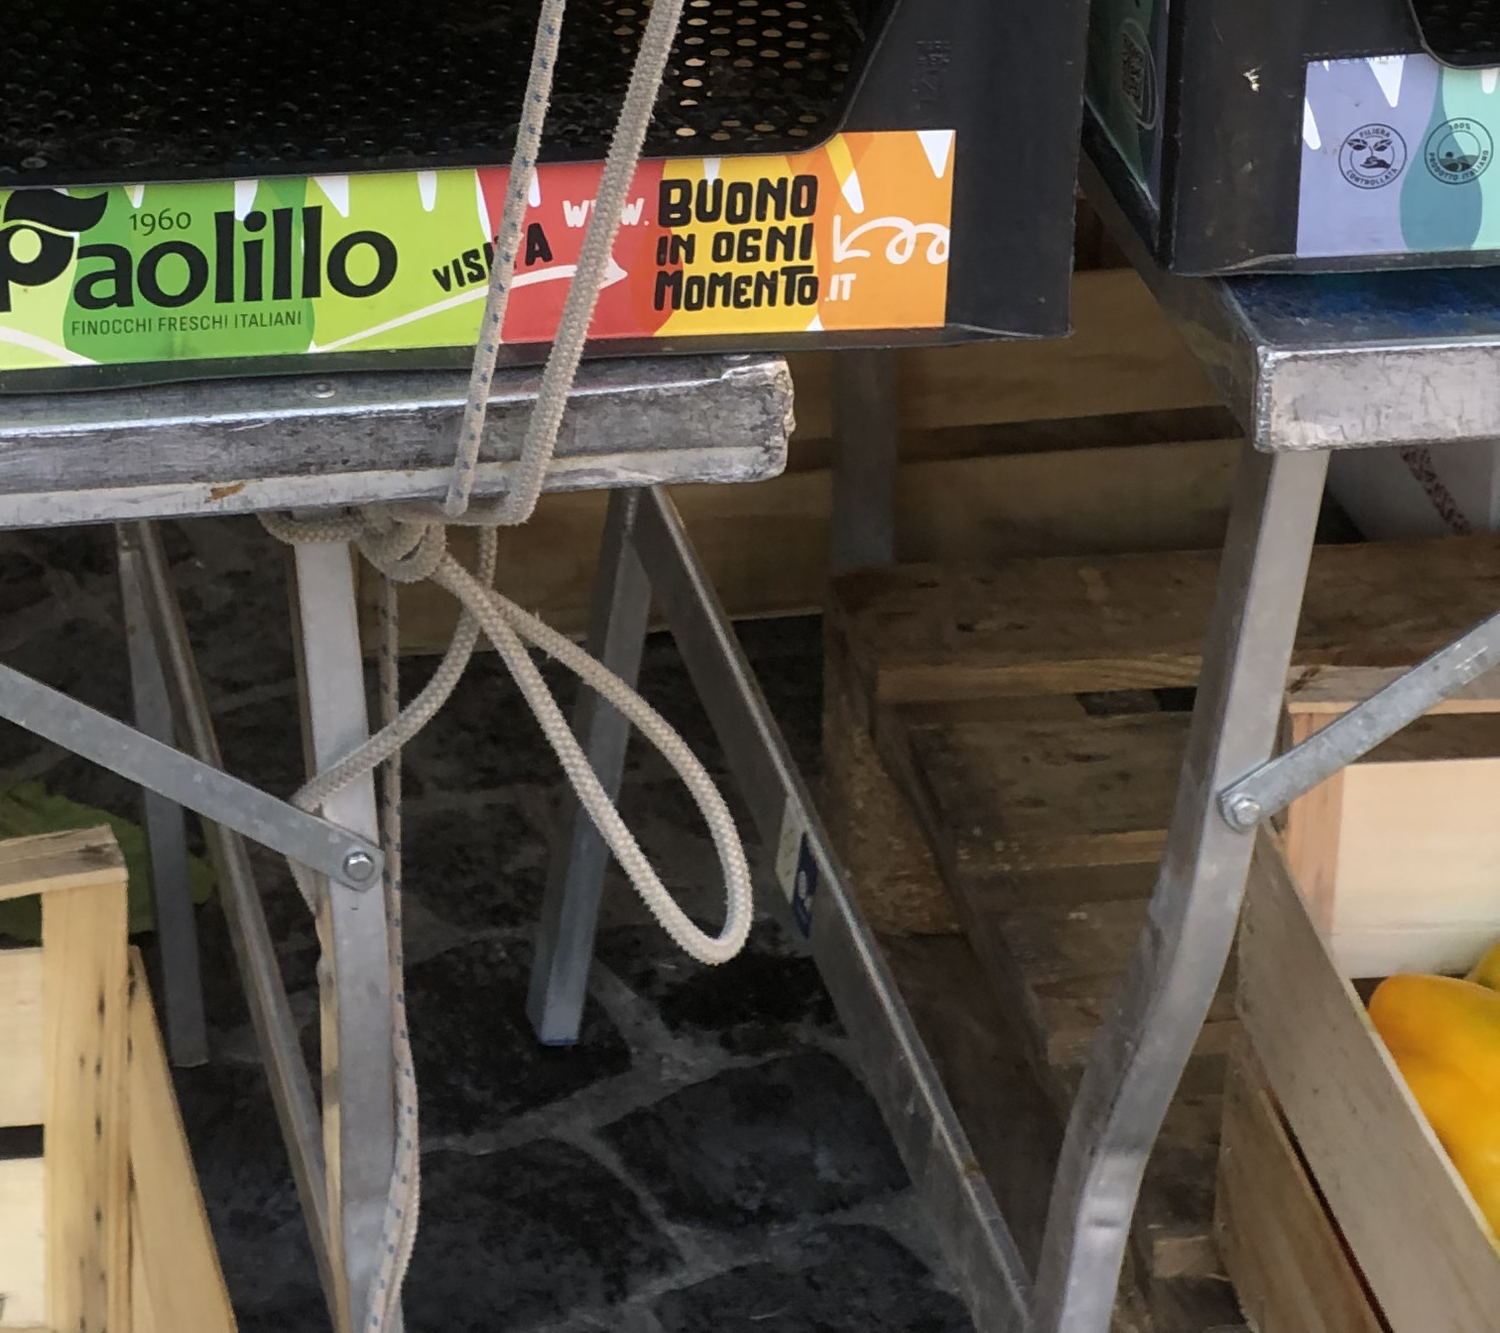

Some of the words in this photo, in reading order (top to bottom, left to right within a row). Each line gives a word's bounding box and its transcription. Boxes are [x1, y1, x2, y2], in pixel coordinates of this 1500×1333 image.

[1359, 128, 1391, 138] FILIERA
[1346, 168, 1398, 186] CONTROLLATA
[658, 175, 818, 228] BUONO
[128, 207, 192, 236] 1960
[431, 222, 553, 293] VISIA
[656, 233, 696, 267] IN
[711, 223, 814, 264] OGNI
[653, 266, 819, 311] MOMENTO
[71, 317, 155, 337] FINOCCHI
[157, 313, 230, 332] FRESCHI
[233, 310, 302, 329] ITALIANI
